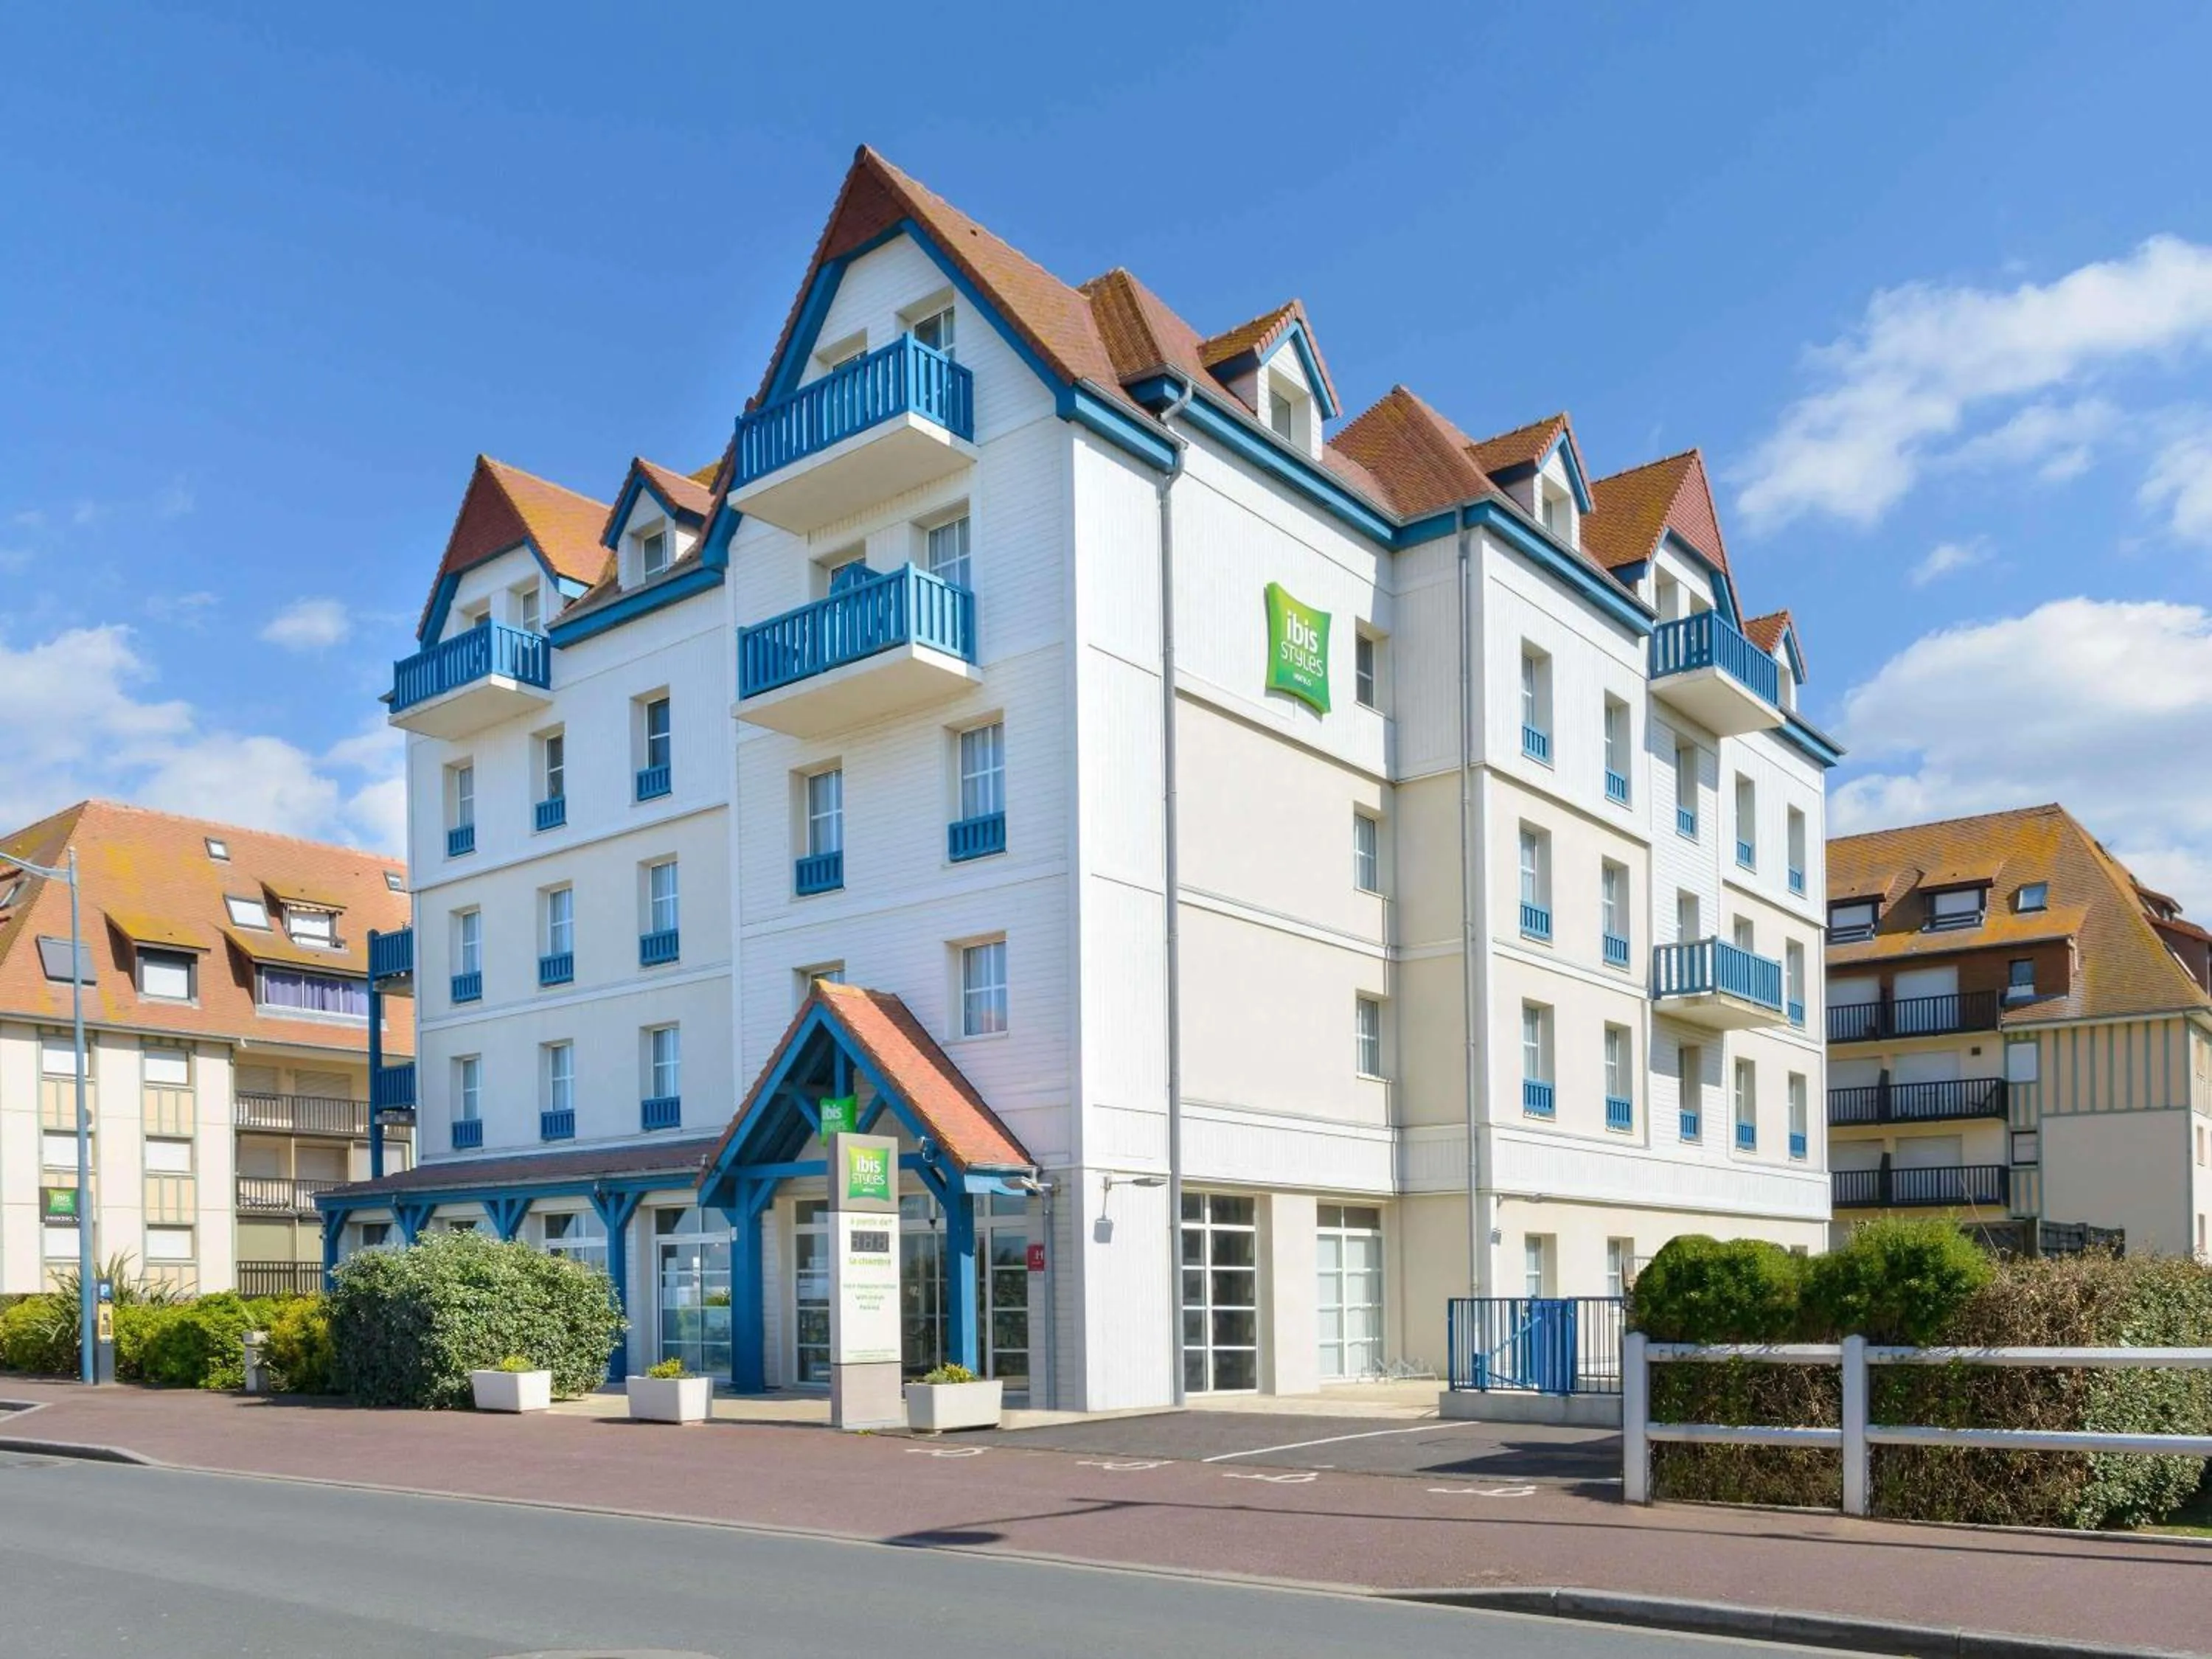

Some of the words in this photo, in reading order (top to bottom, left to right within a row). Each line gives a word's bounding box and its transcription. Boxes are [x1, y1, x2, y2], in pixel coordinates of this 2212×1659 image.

[1287, 610, 1318, 653] ibis
[821, 1104, 842, 1120] ibis
[856, 1155, 881, 1173] ibis
[100, 1284, 110, 1296] P
